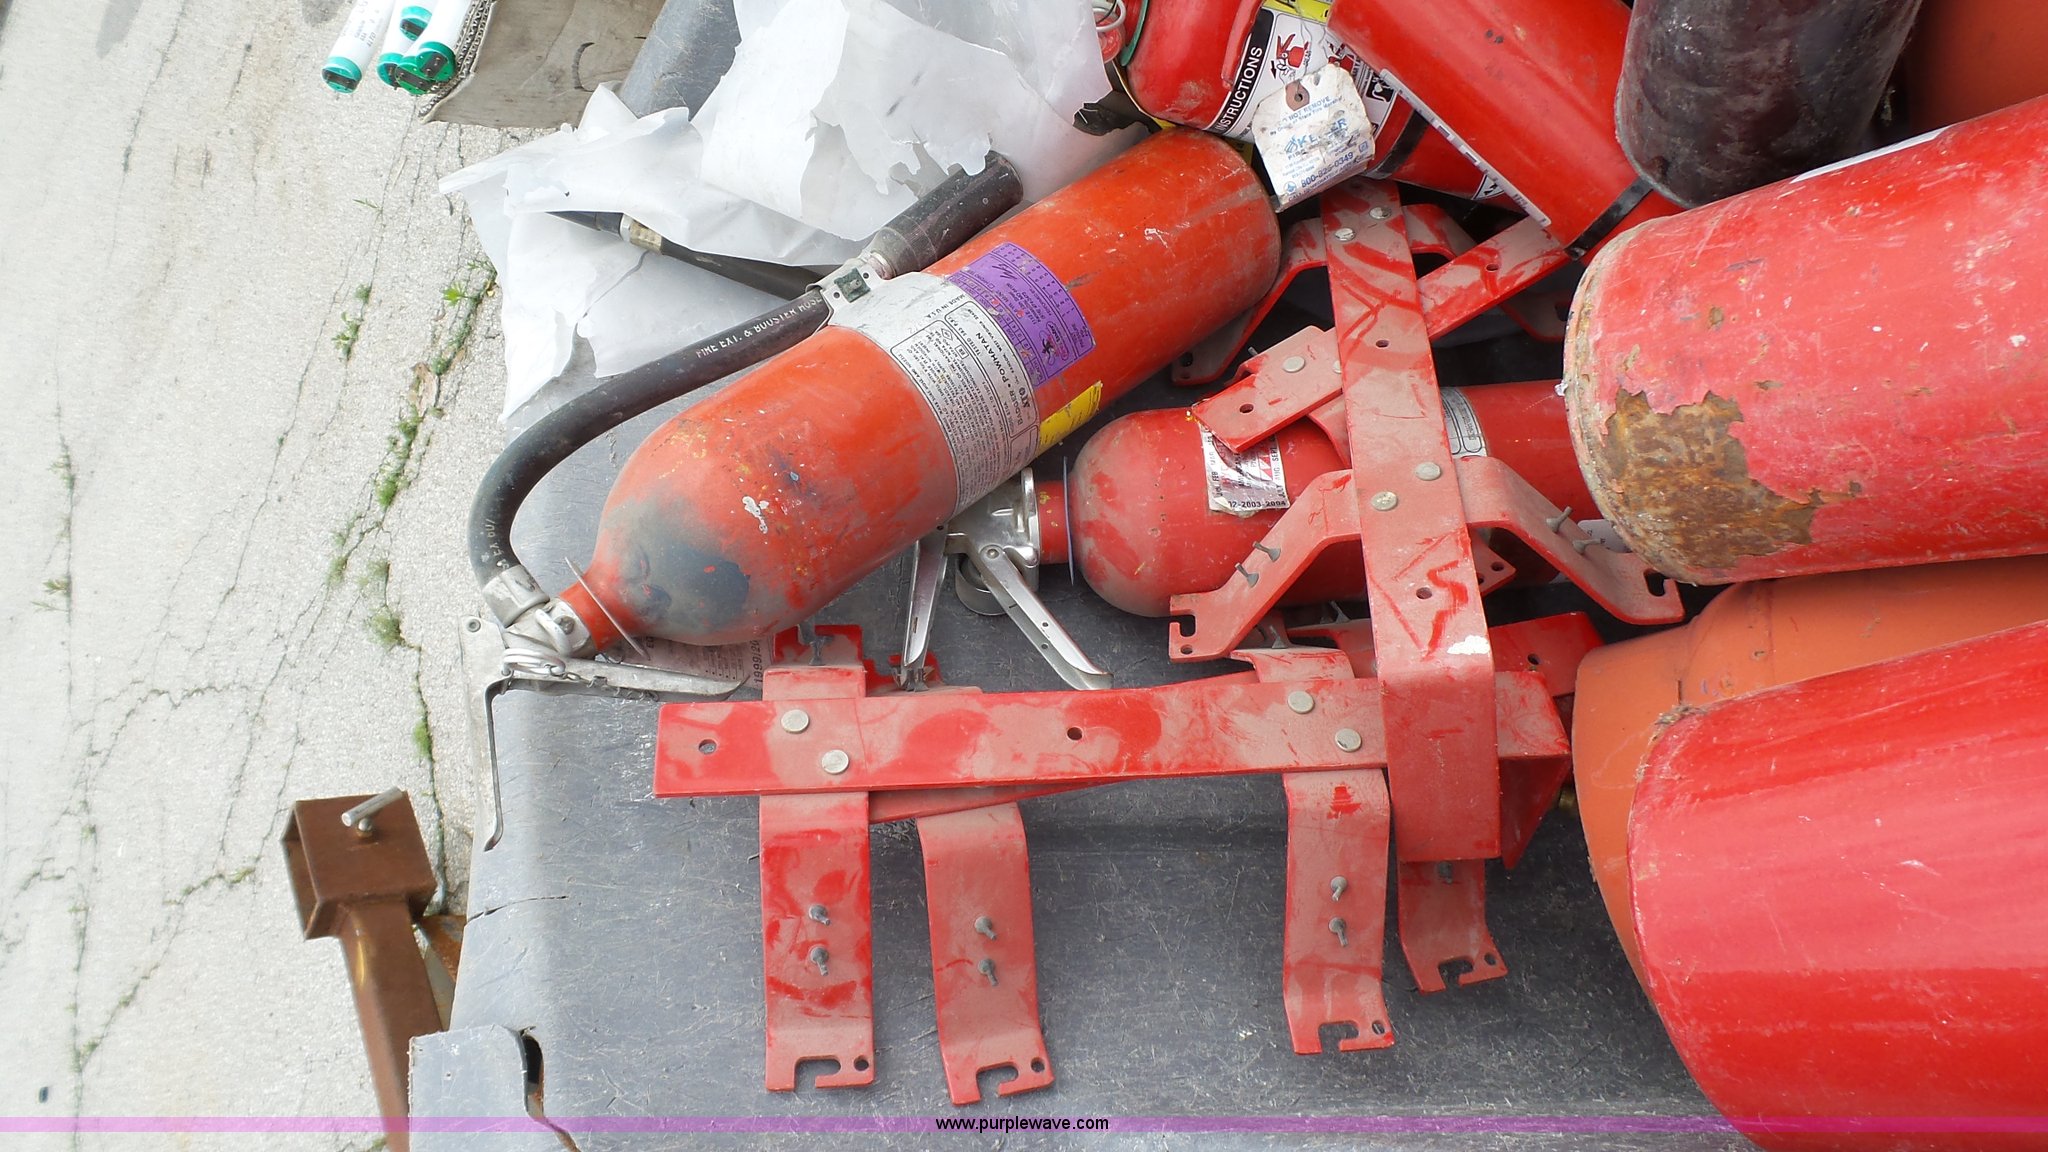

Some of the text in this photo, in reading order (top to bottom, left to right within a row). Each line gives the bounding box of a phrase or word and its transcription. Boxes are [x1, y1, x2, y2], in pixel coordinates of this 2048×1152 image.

[1296, 116, 1347, 147] KEER
[974, 331, 1009, 383] POWHATAN
[750, 639, 762, 682] 1999/20
